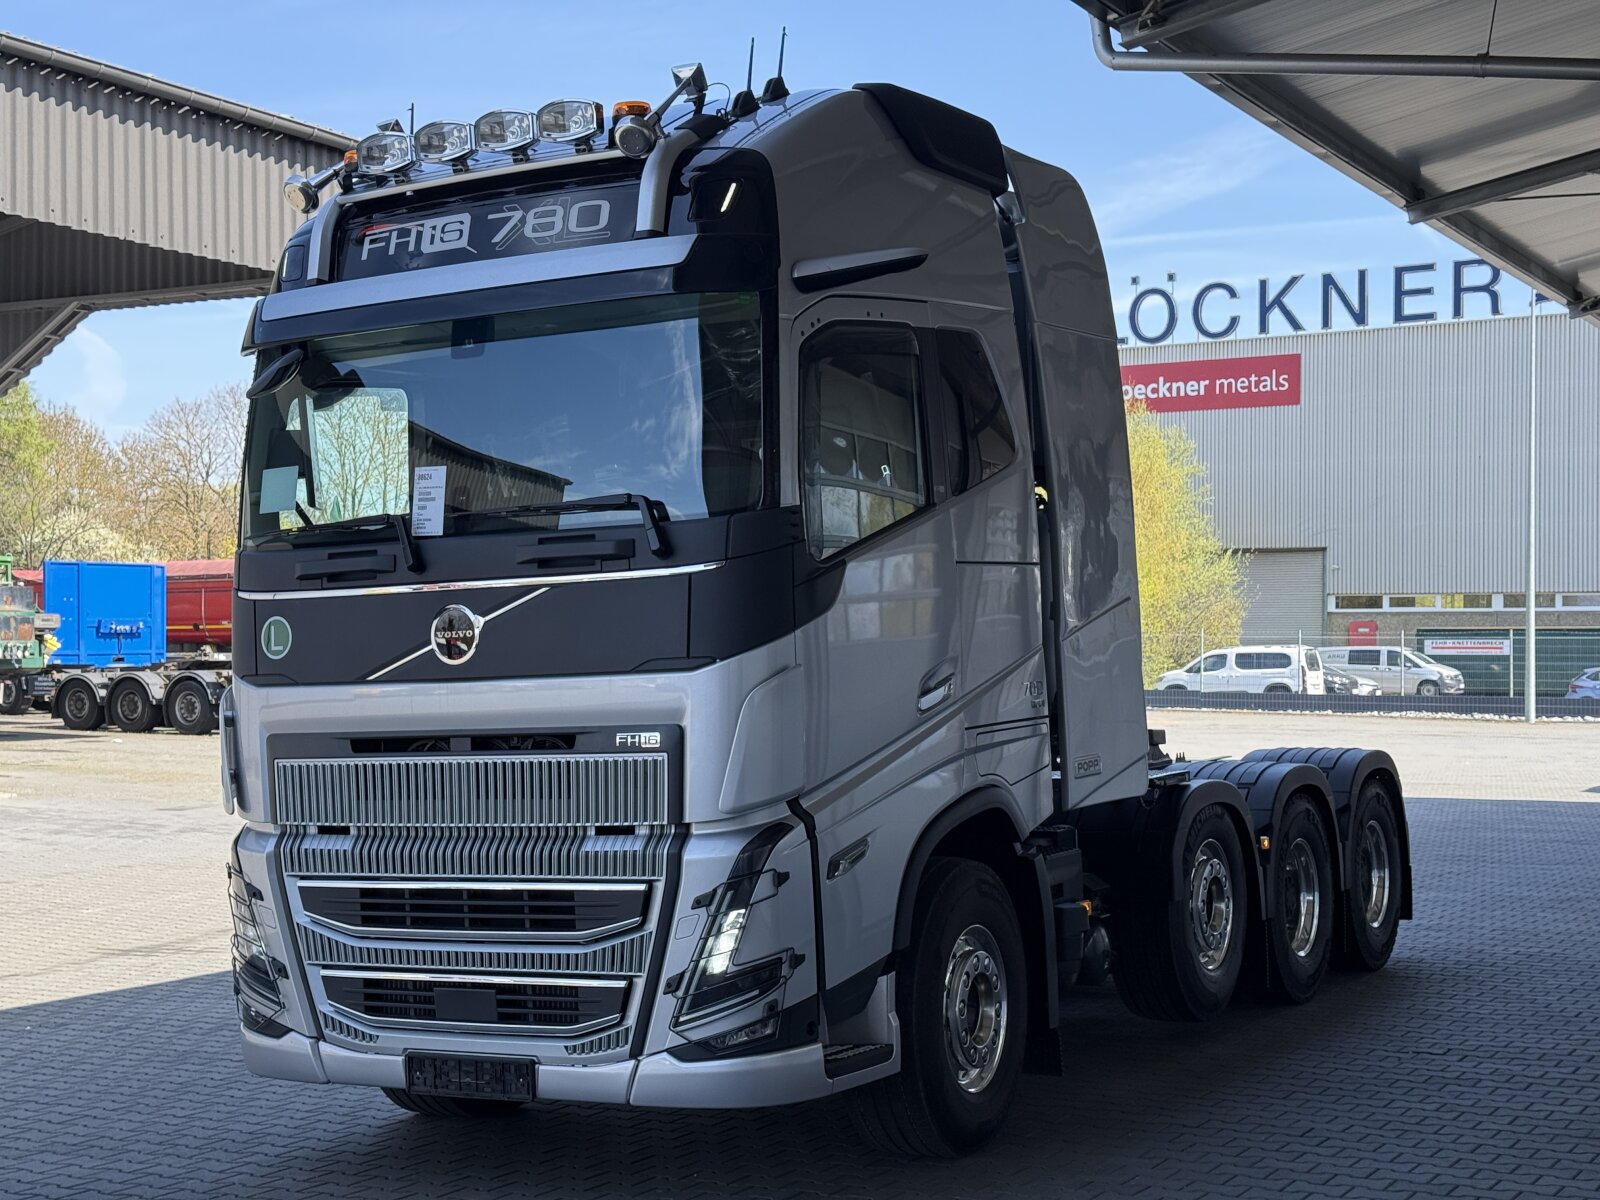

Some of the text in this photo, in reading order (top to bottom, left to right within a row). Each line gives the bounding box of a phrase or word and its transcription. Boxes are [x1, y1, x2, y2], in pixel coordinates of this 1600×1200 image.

[361, 199, 611, 261] FH16 780
[1117, 257, 1502, 344] ÖCKNER
[1215, 368, 1290, 395] metals
[270, 625, 284, 652] L
[435, 629, 473, 639] VOLVO
[615, 731, 661, 748] FH16
[1077, 758, 1099, 775] POPP
